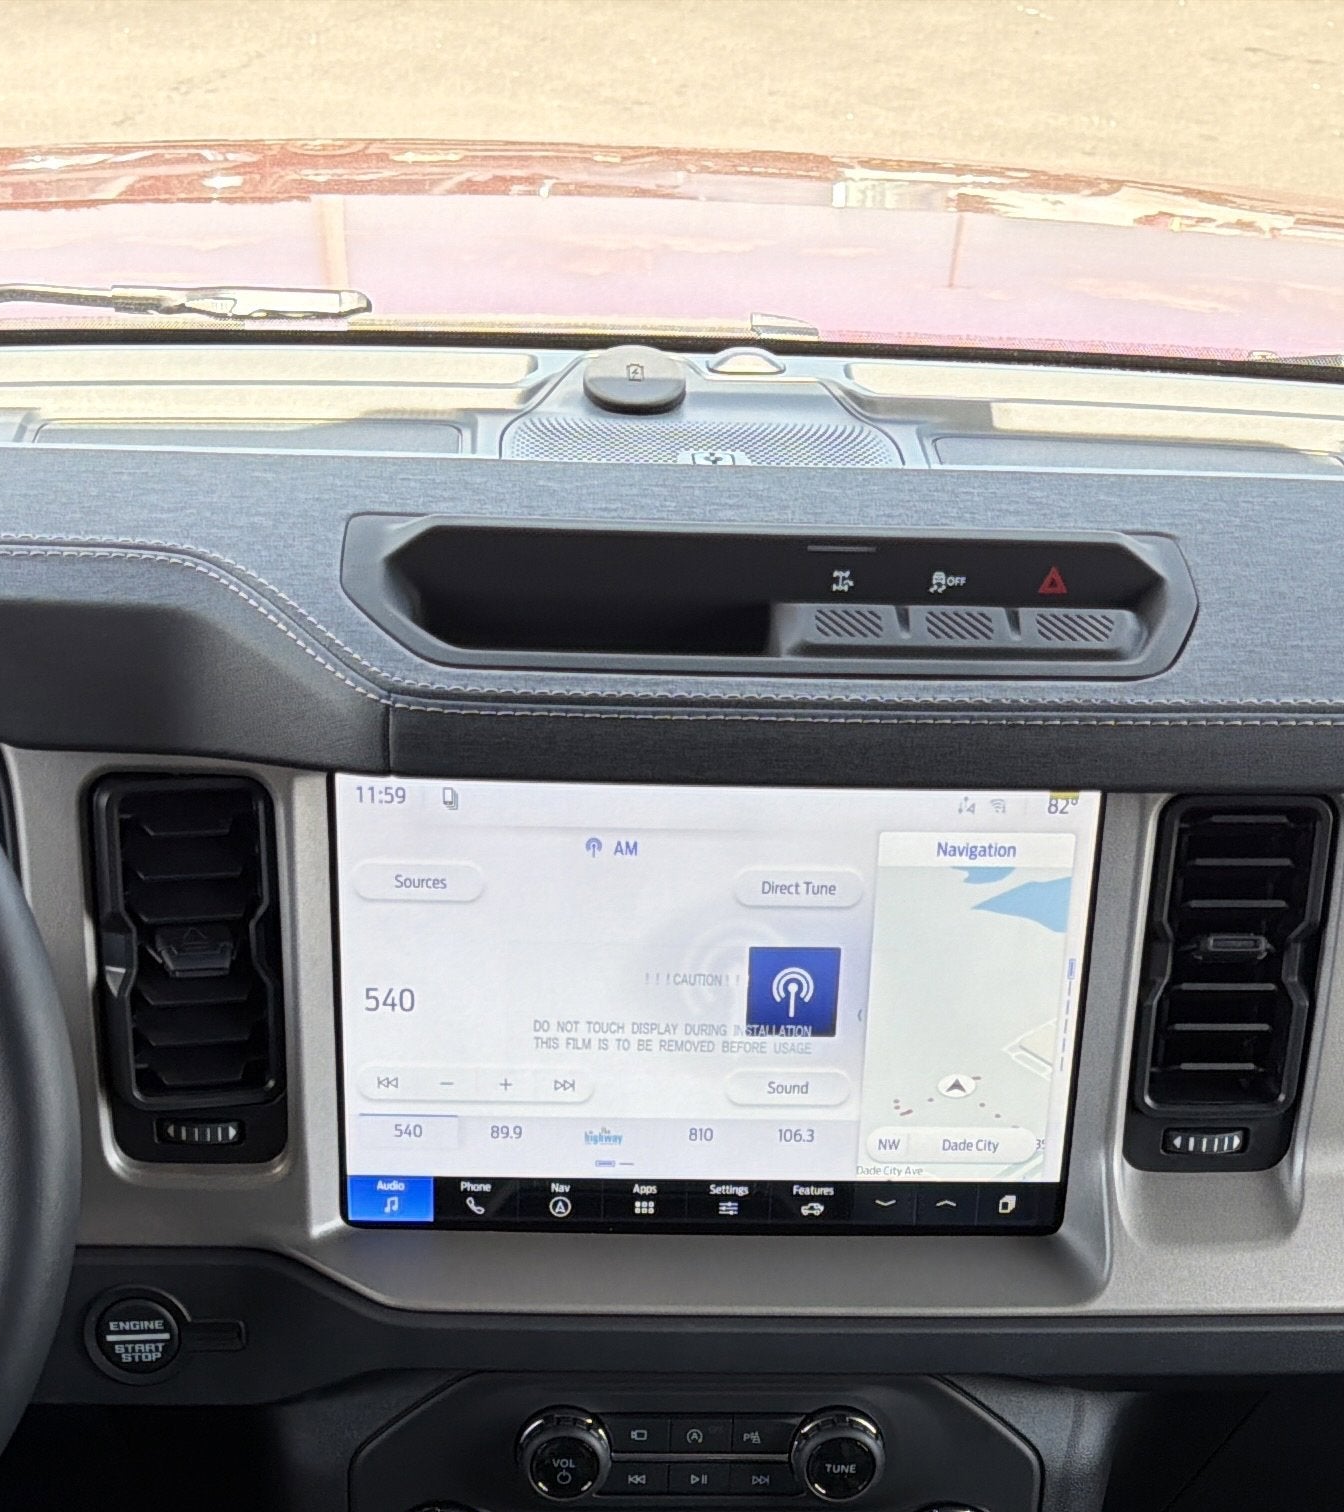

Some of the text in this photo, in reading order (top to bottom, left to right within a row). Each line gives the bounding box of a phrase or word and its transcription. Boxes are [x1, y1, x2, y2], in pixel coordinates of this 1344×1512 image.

[946, 576, 967, 587] OFF
[356, 786, 406, 804] 11:59
[1047, 795, 1079, 815] 82°
[614, 841, 638, 856] AM
[936, 841, 1017, 860] Navigation
[394, 874, 447, 890] Sources
[761, 881, 837, 896] Direct Tune
[365, 988, 415, 1012] 540
[533, 1020, 813, 1038] DO NOT TOUCH DISPLAY DURING INSTALLATION
[534, 1037, 813, 1055] THIS FILM IS TO BE REMOVED BEFORE USAGE
[767, 1081, 809, 1095] Sound
[394, 1124, 423, 1138] 540
[490, 1125, 523, 1140] 89.9
[688, 1128, 714, 1142] 810
[777, 1128, 815, 1143] 106.3
[877, 1138, 900, 1151] NW
[942, 1139, 1000, 1154] Dade City
[856, 1165, 924, 1177] Dade City Ave
[376, 1180, 405, 1192] Audio
[460, 1182, 491, 1193] Phone
[551, 1183, 571, 1193] Nav
[633, 1184, 657, 1196] Apps
[709, 1185, 749, 1197] Settings
[792, 1185, 834, 1196] Features
[109, 1320, 164, 1331] ENGINE
[114, 1343, 165, 1354] START
[121, 1352, 162, 1363] STOP
[552, 1458, 576, 1469] VOL
[825, 1463, 857, 1474] TUNE
